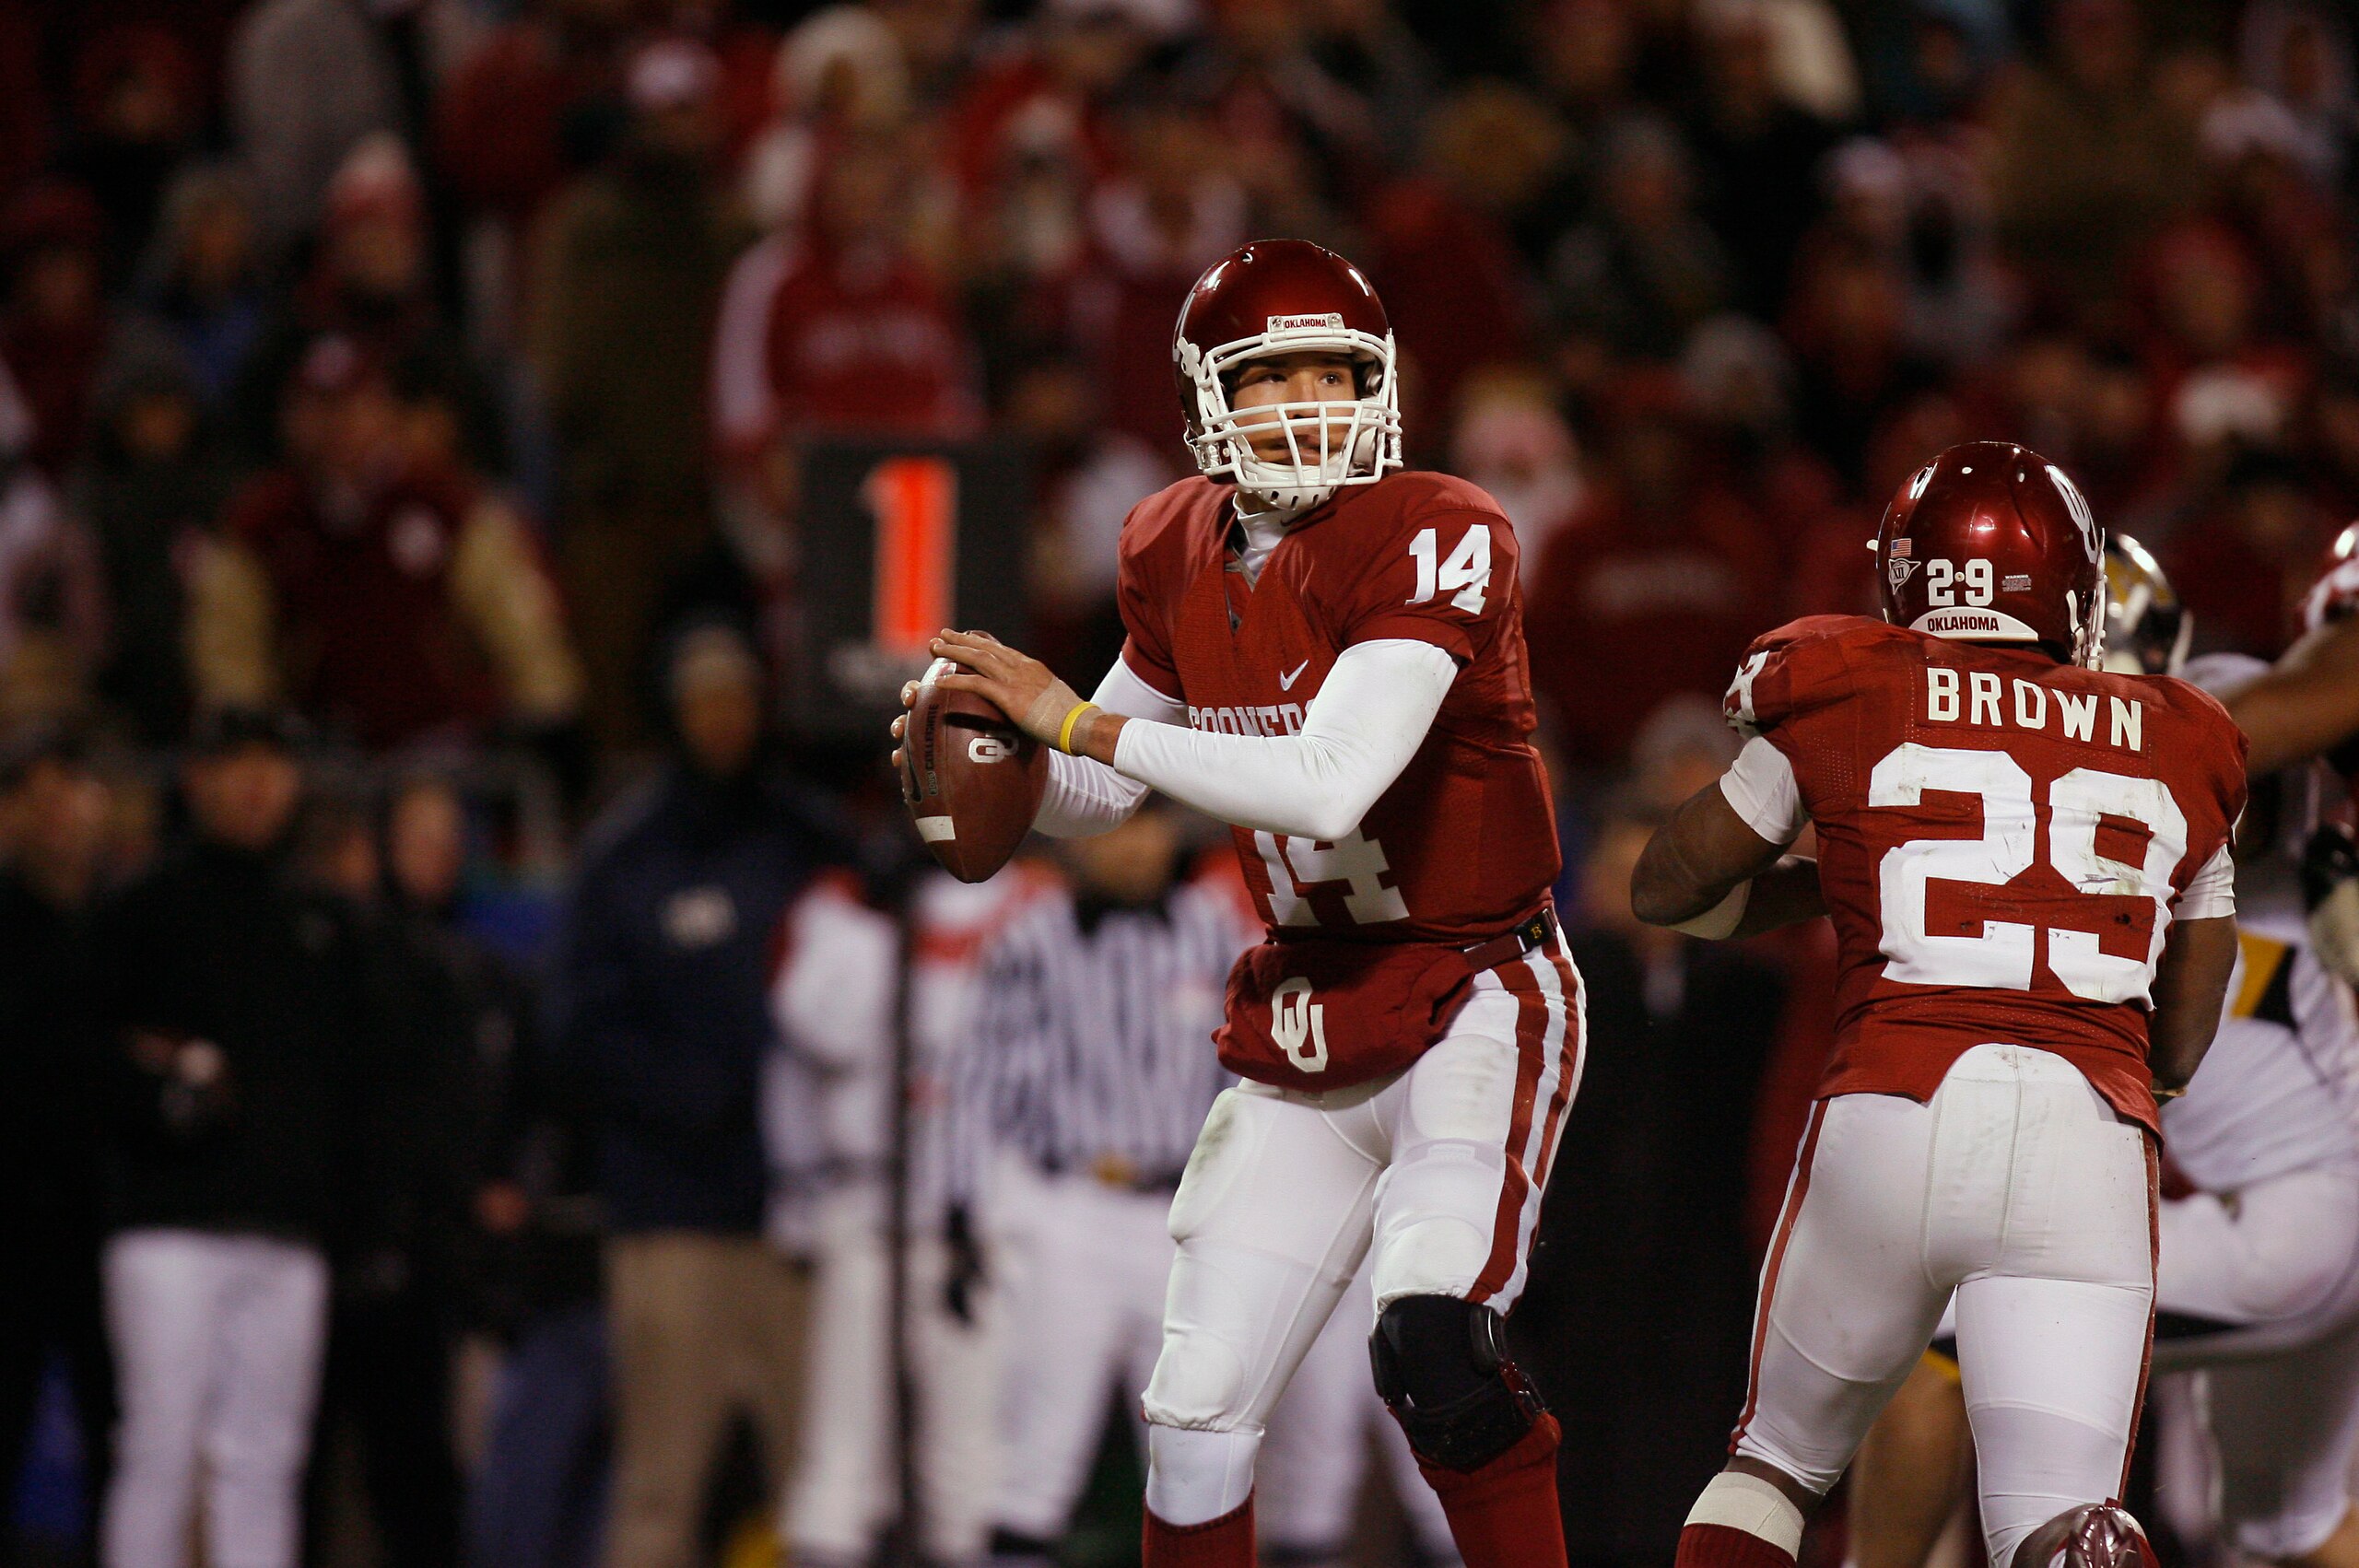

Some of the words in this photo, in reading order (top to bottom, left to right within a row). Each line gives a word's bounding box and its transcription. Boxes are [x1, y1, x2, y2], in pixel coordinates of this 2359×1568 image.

[1285, 318, 1328, 329] OKLAHOMA
[856, 456, 959, 654] 1
[1404, 523, 1492, 615] 14
[1927, 558, 1993, 607] 29
[1927, 616, 2000, 632] OKLAHOMA
[1926, 667, 2142, 752] BROWN
[1868, 742, 2189, 1012] 29
